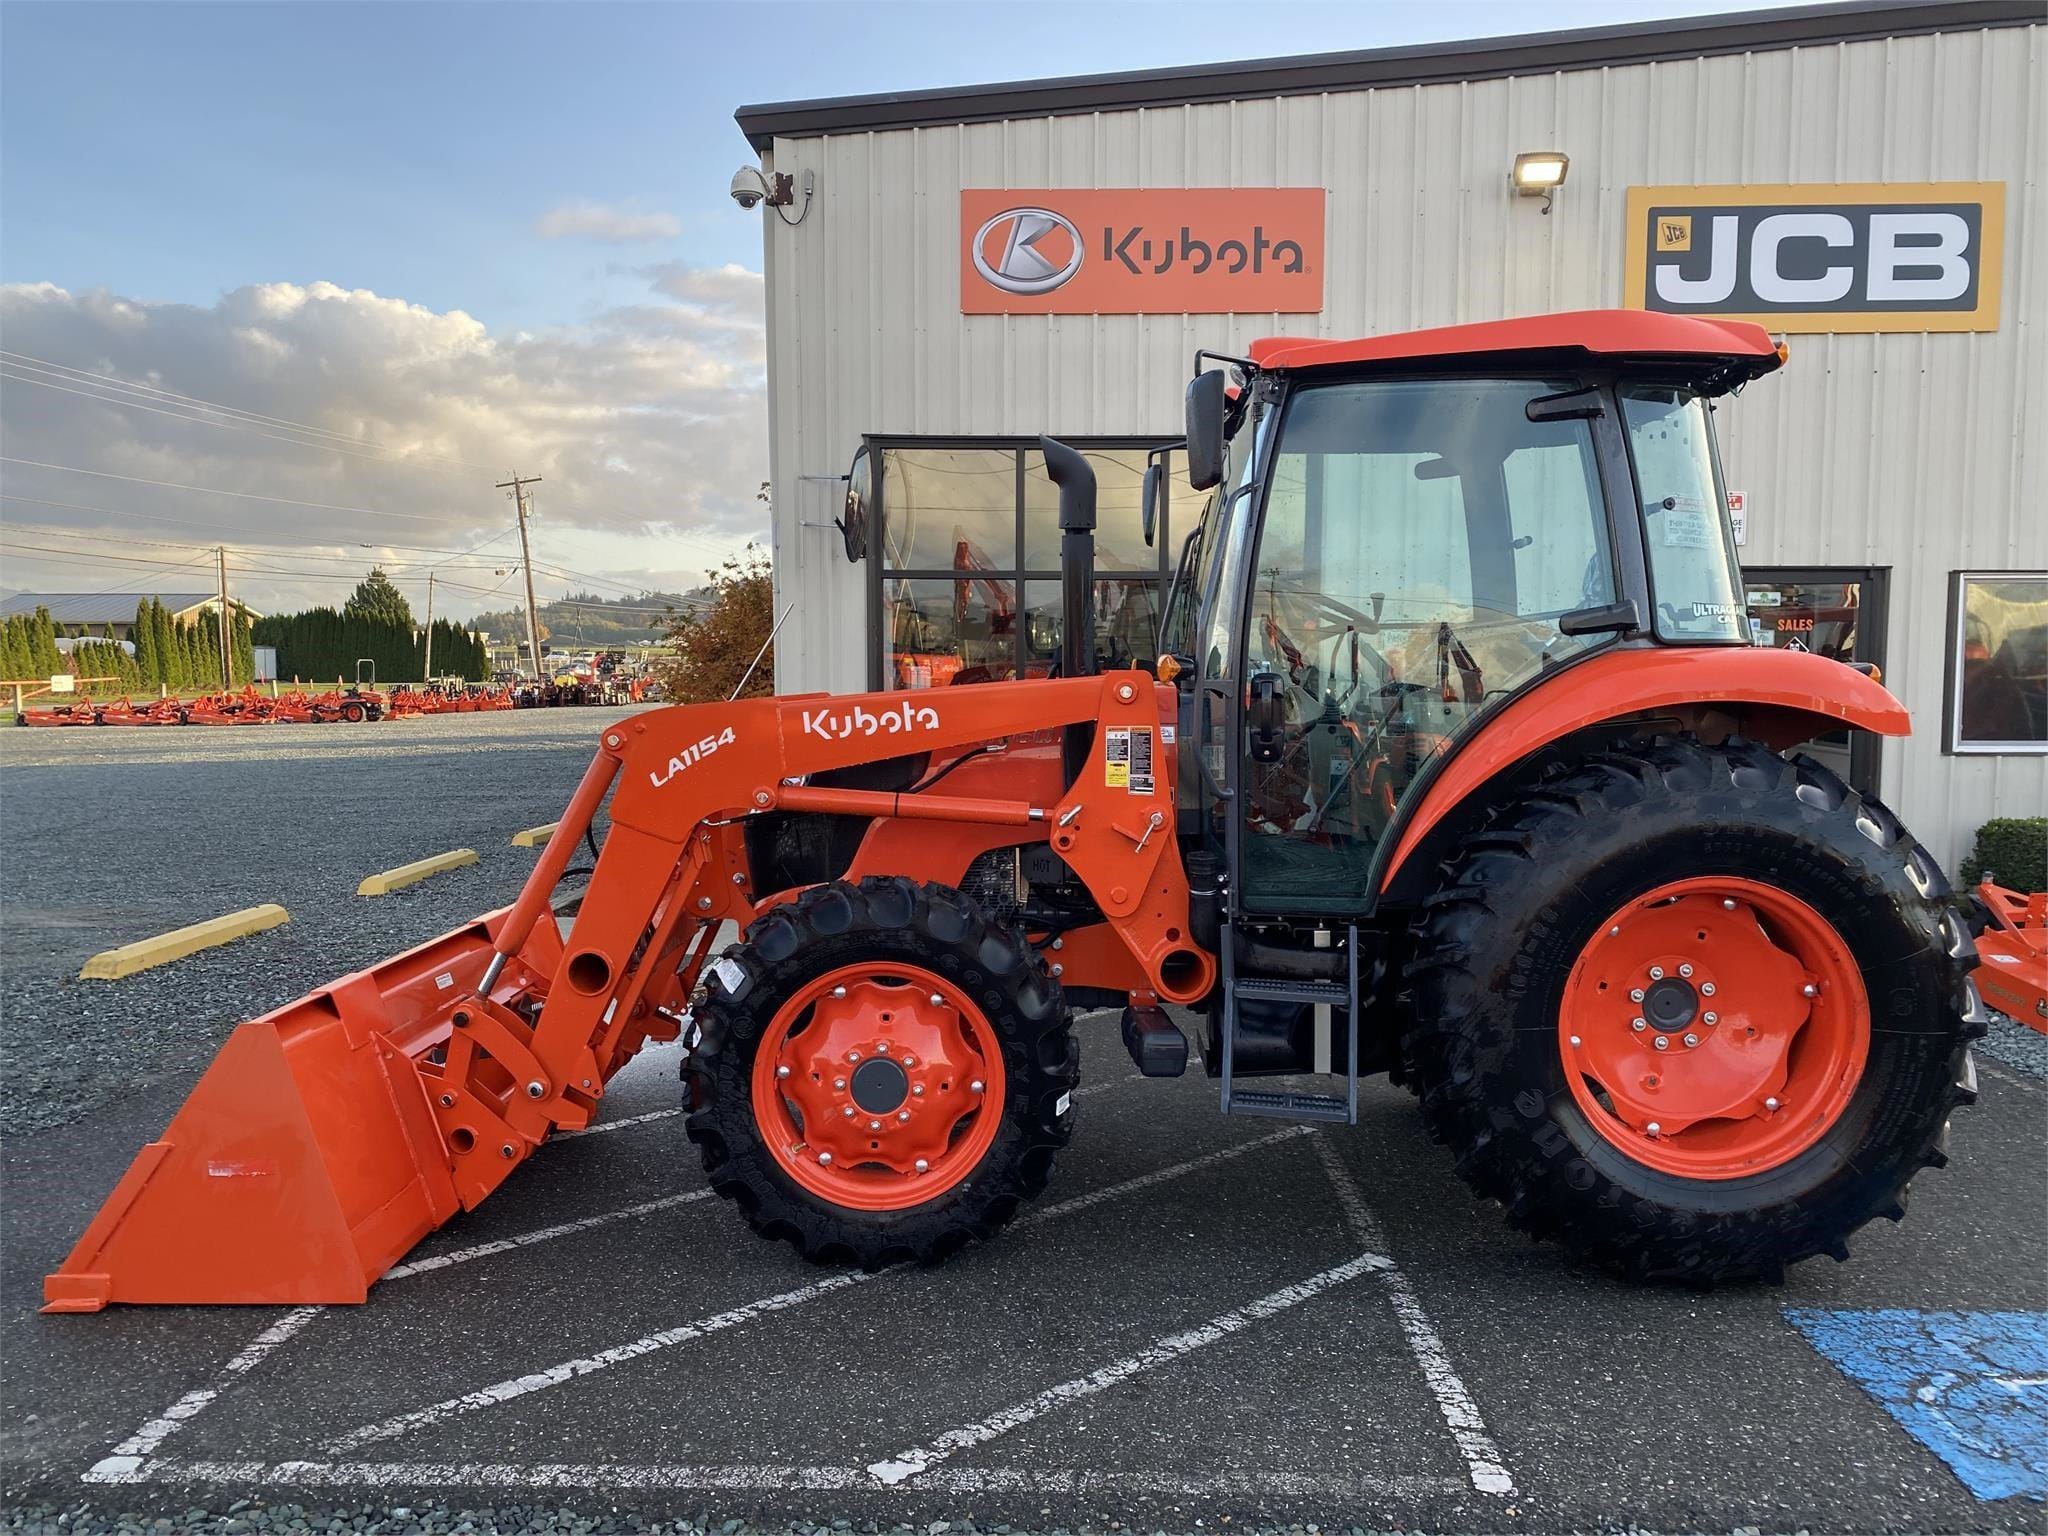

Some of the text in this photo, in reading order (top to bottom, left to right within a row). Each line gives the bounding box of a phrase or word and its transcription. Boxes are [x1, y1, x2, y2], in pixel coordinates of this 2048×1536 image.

[1104, 226, 1303, 274] Kubota
[1665, 224, 1687, 243] JCB
[1655, 213, 1970, 304] JCB
[1777, 619, 1814, 632] SALES
[802, 701, 940, 740] Kubota
[649, 726, 737, 788] LA1154
[1032, 857, 1051, 873] HOT
